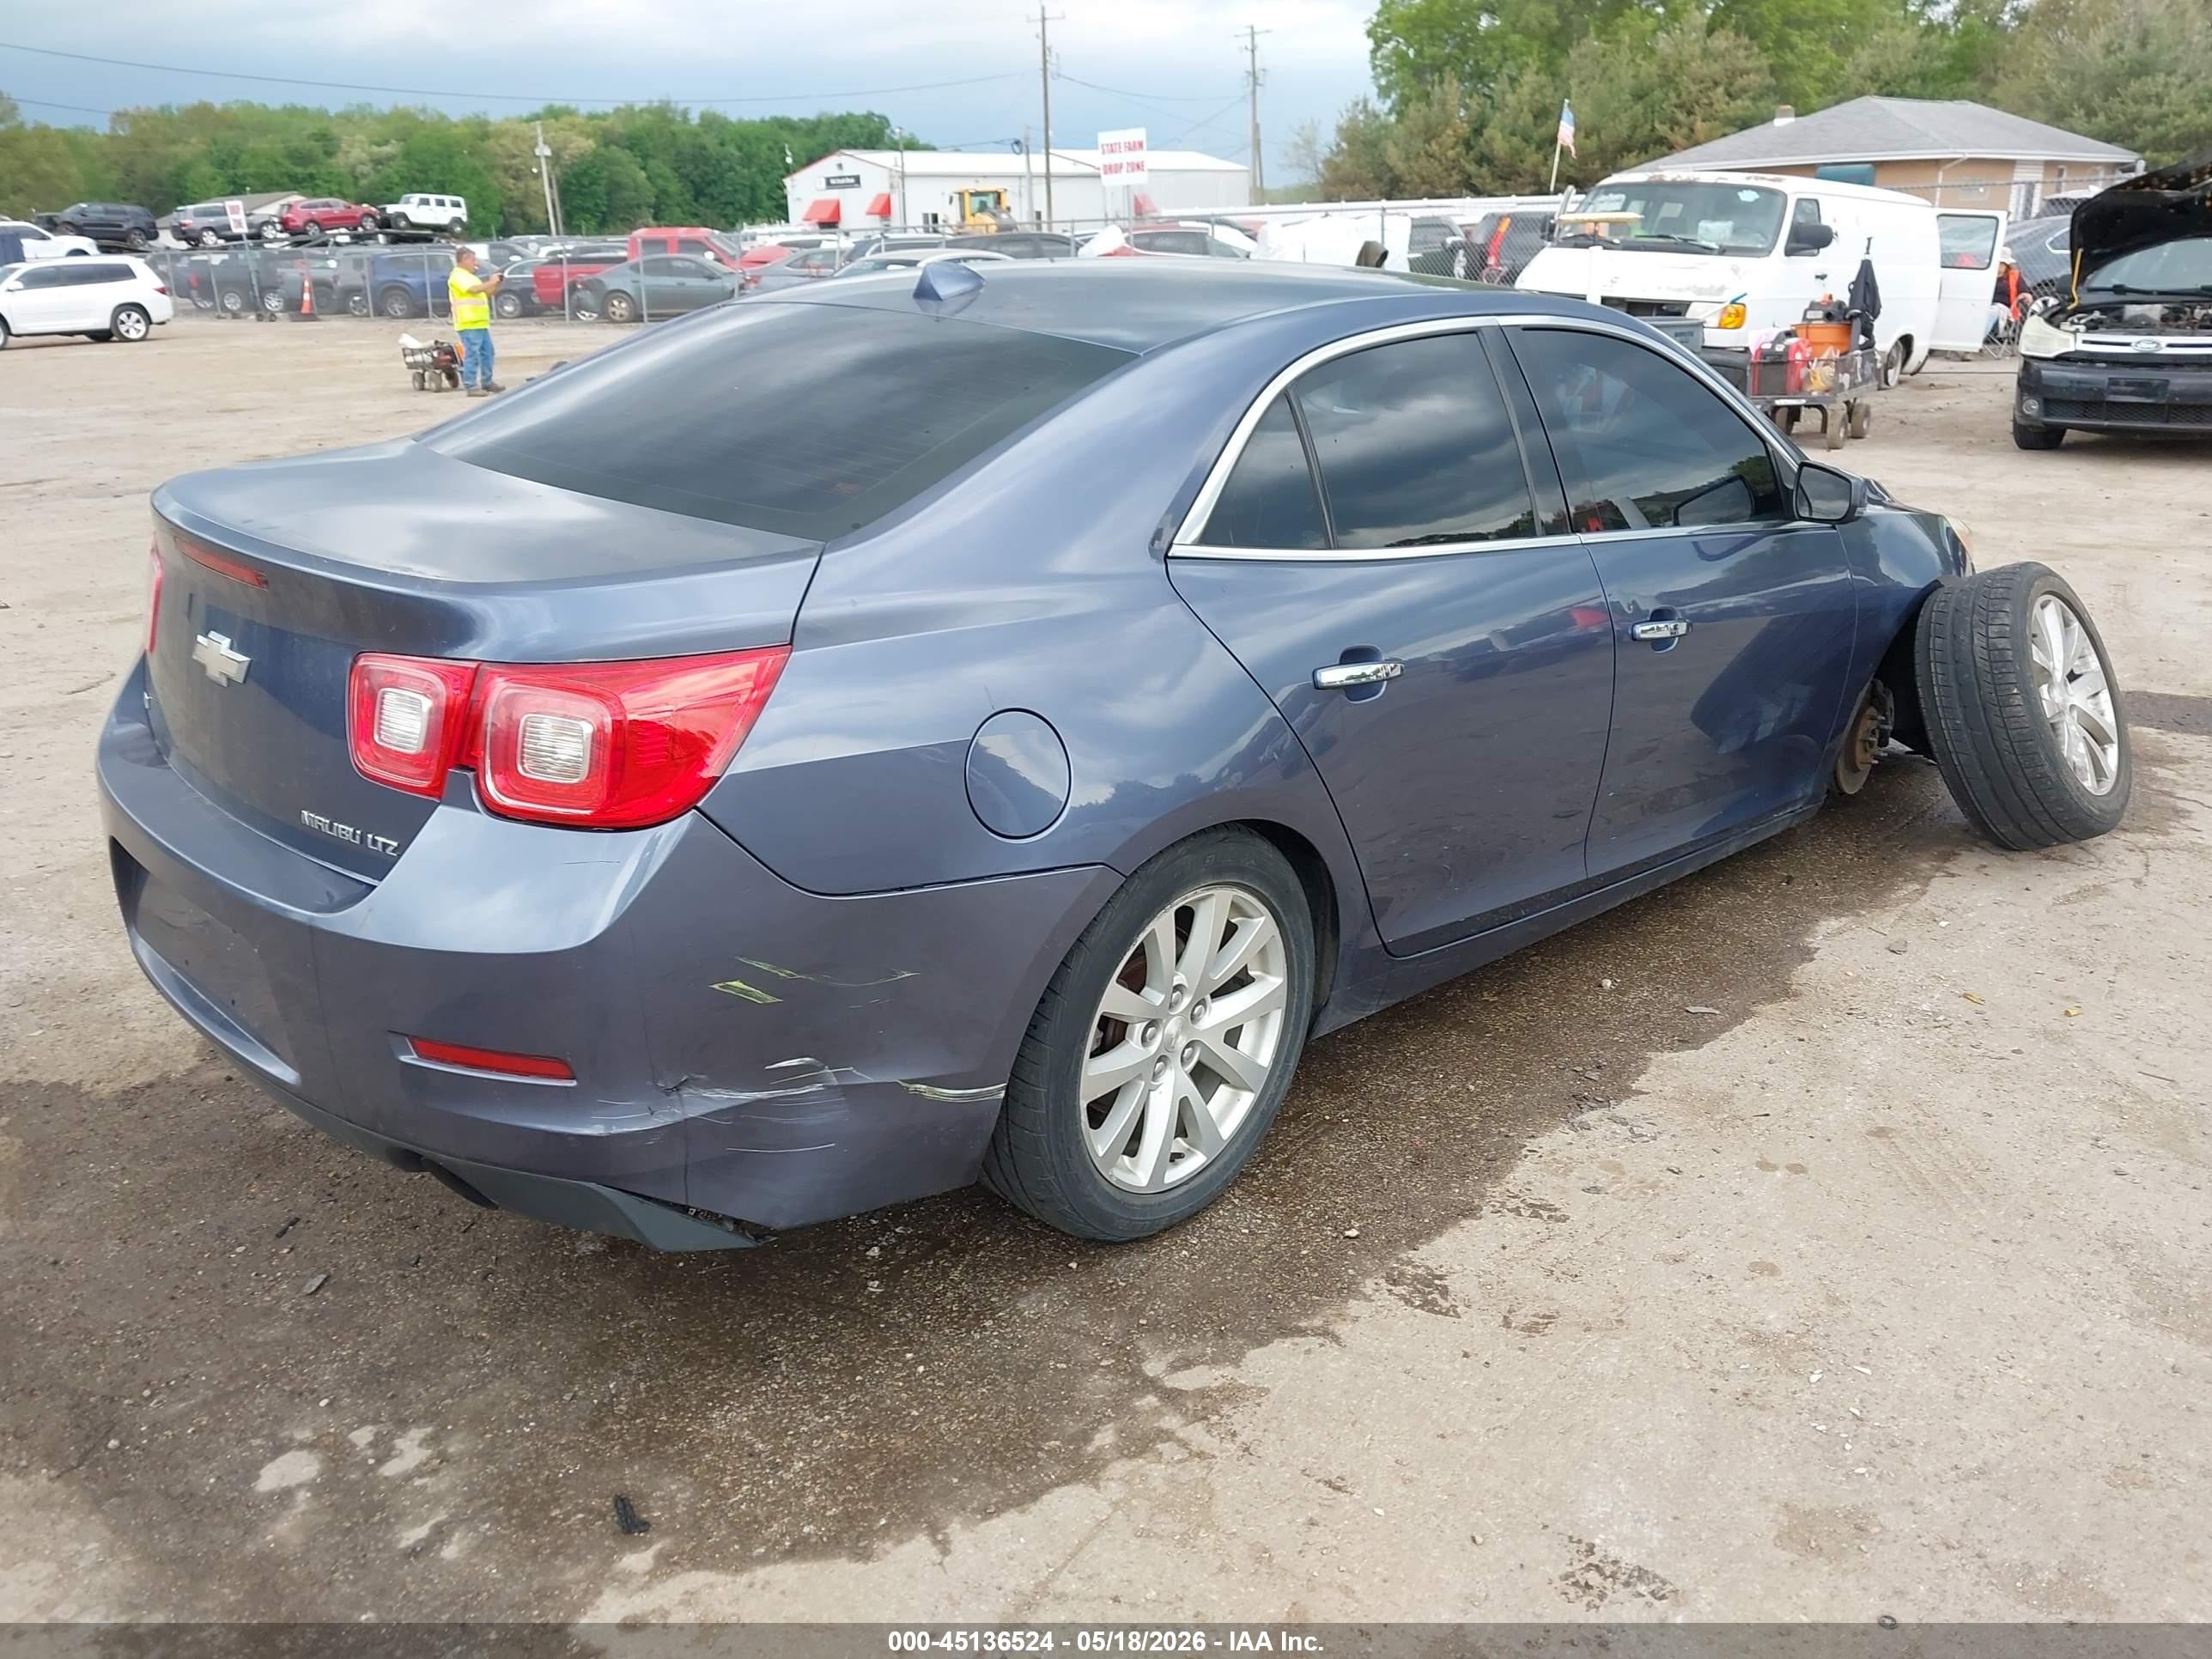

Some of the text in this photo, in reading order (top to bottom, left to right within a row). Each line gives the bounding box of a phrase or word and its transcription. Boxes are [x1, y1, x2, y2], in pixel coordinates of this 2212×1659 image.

[1101, 140, 1143, 155] STATE FARM
[1103, 160, 1145, 174] DROP ZONE
[300, 810, 398, 857] MALIBU LTZ
